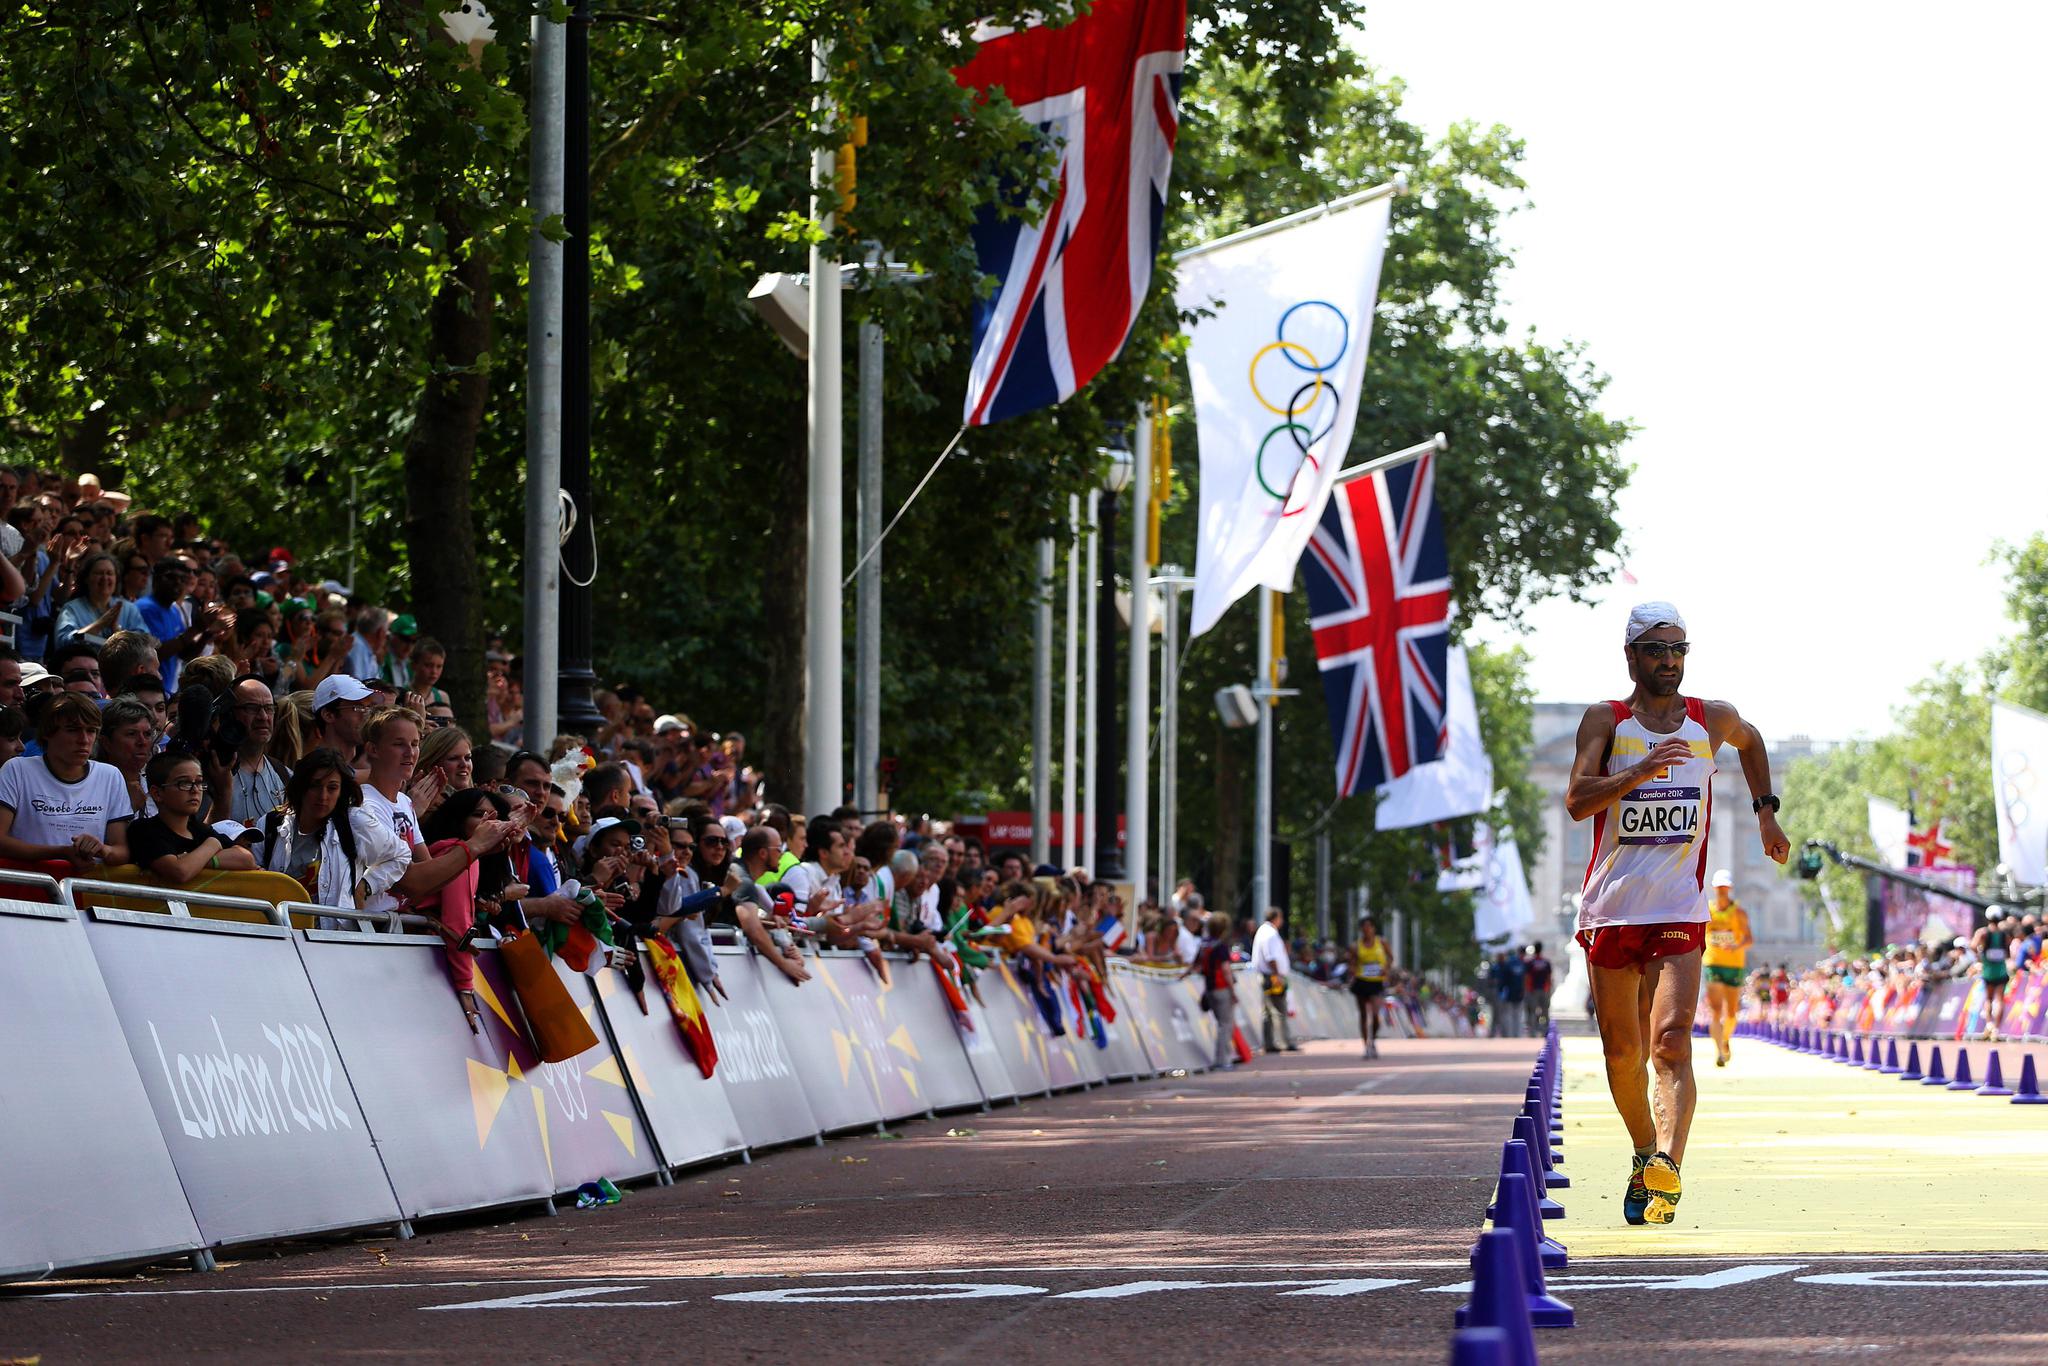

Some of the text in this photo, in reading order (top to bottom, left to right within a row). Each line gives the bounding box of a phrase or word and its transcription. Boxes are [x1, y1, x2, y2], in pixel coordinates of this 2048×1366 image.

[1639, 791, 1666, 799] London
[1622, 805, 1698, 833] GARCIA
[148, 1015, 352, 1140] London 2012
